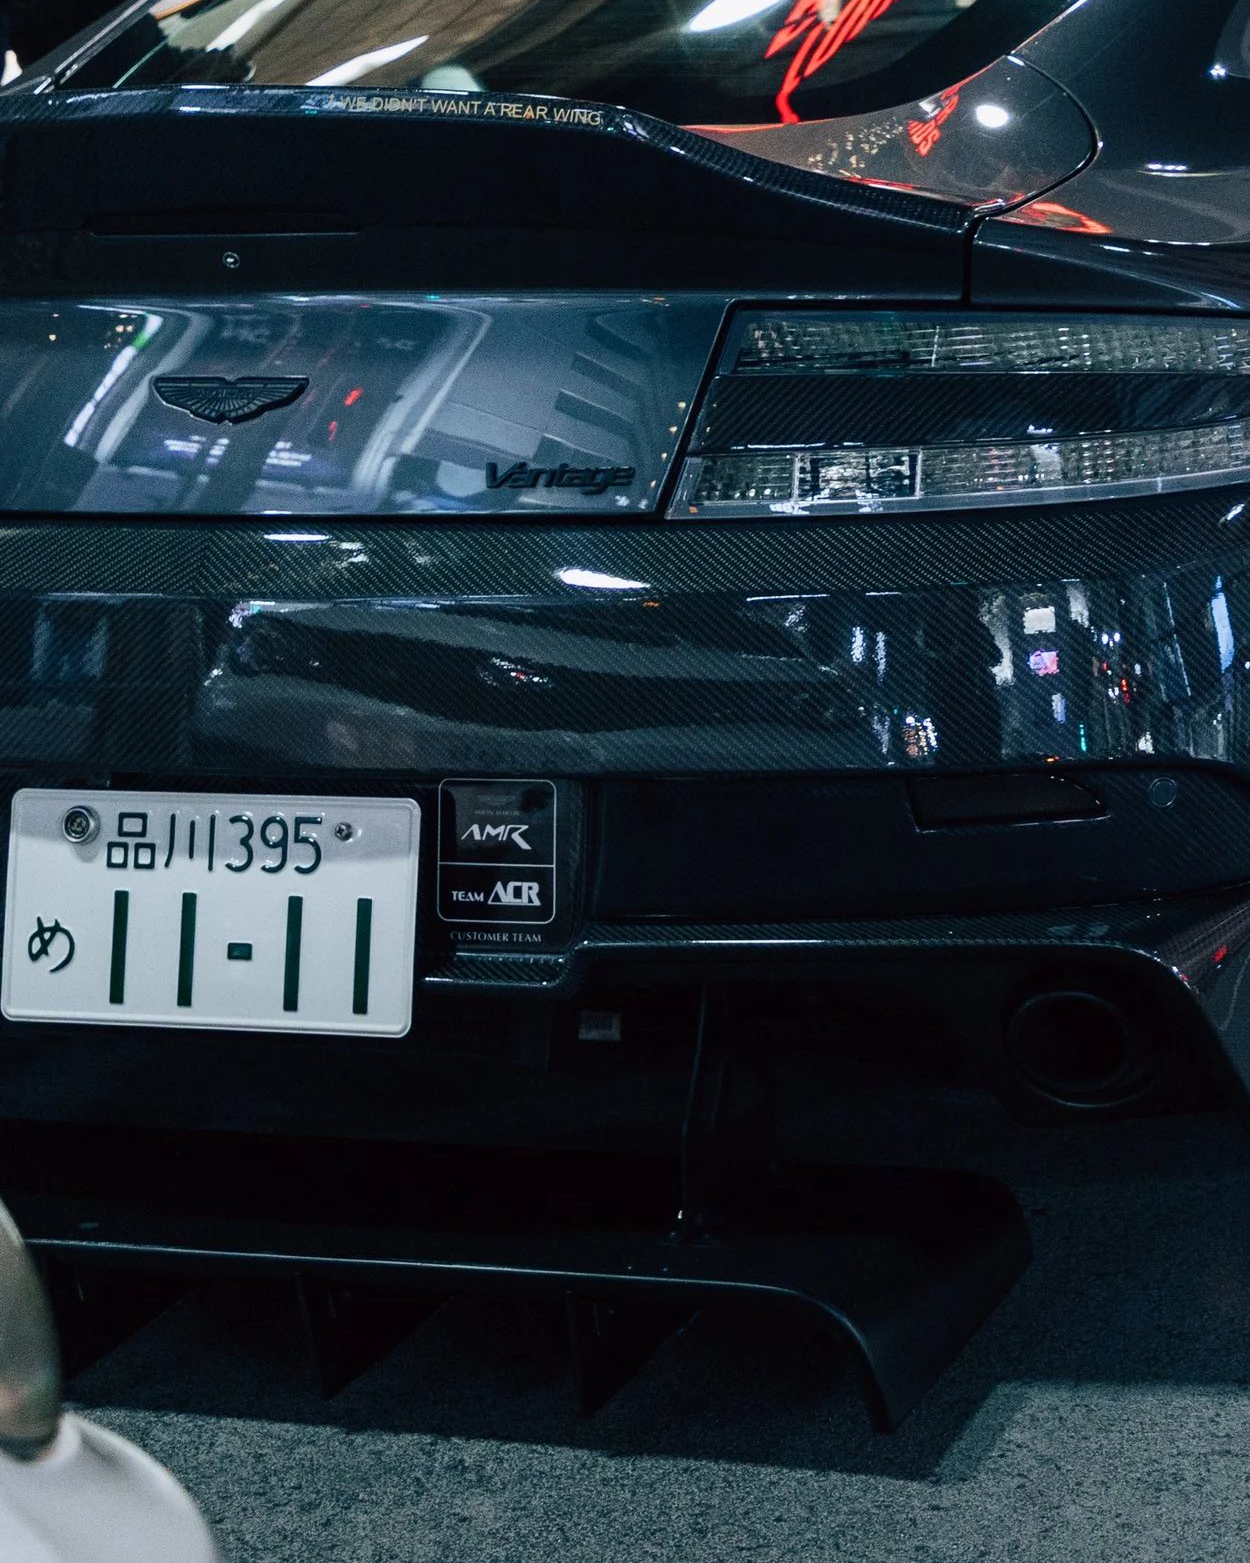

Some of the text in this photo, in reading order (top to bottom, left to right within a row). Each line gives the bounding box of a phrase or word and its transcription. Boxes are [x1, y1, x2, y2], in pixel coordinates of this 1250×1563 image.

[340, 95, 601, 125] WE DIDN'T WANT A REAR WING
[485, 461, 635, 495] Vantage
[461, 824, 532, 850] AMR
[452, 881, 541, 906] TEAM ACR
[28, 916, 75, 973] め
[450, 931, 542, 942] CUSTOMER TEAM
